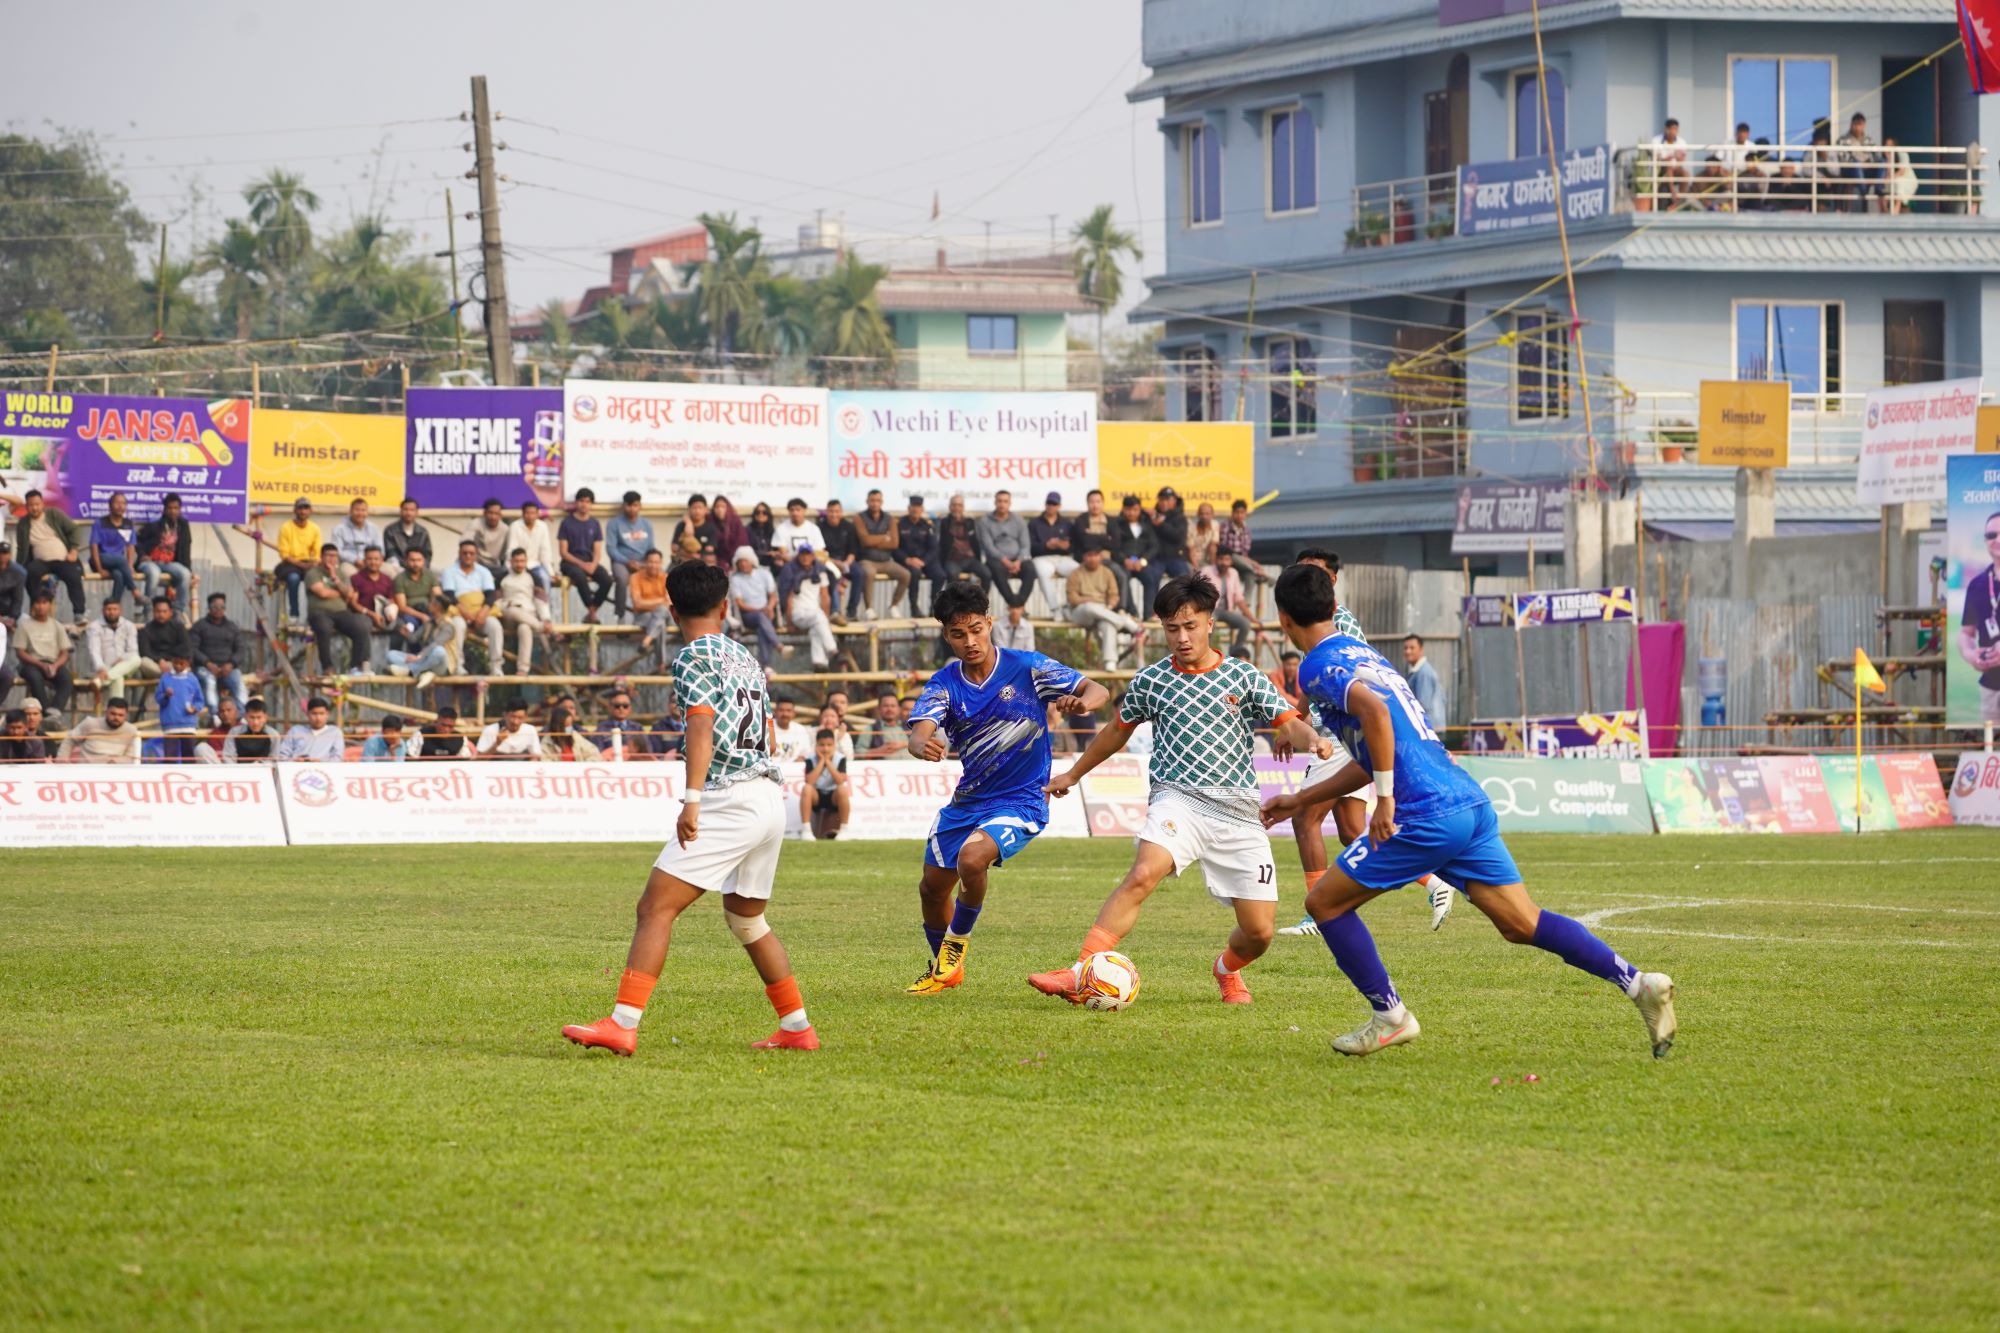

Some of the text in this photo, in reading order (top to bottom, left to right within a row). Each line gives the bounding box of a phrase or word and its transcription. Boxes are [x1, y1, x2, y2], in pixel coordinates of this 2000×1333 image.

[6, 393, 73, 414] WORLD
[607, 394, 820, 429] भद्रपुर नगरपालिका
[4, 413, 69, 428] & Decor
[76, 407, 201, 444] JANSA
[872, 410, 1089, 439] Mechi Eye Hospital
[1722, 408, 1766, 425] Himstar
[414, 418, 522, 453] XTREME
[121, 445, 190, 462] CARPETS
[273, 442, 360, 461] Himstar
[1131, 452, 1212, 468] Himstar
[414, 454, 522, 475] ENERGY DRINK
[838, 450, 1087, 480] मेची आँखा अस्पताल
[252, 481, 378, 497] WATER DISPENSER
[34, 772, 261, 805] नगरपालिका
[487, 767, 674, 800] गाउँपालिका
[1554, 780, 1616, 799] Quality
[1549, 799, 1629, 818] Computer
[1000, 827, 1017, 847] 17
[1342, 840, 1369, 870] 12
[1258, 863, 1274, 885] 17
